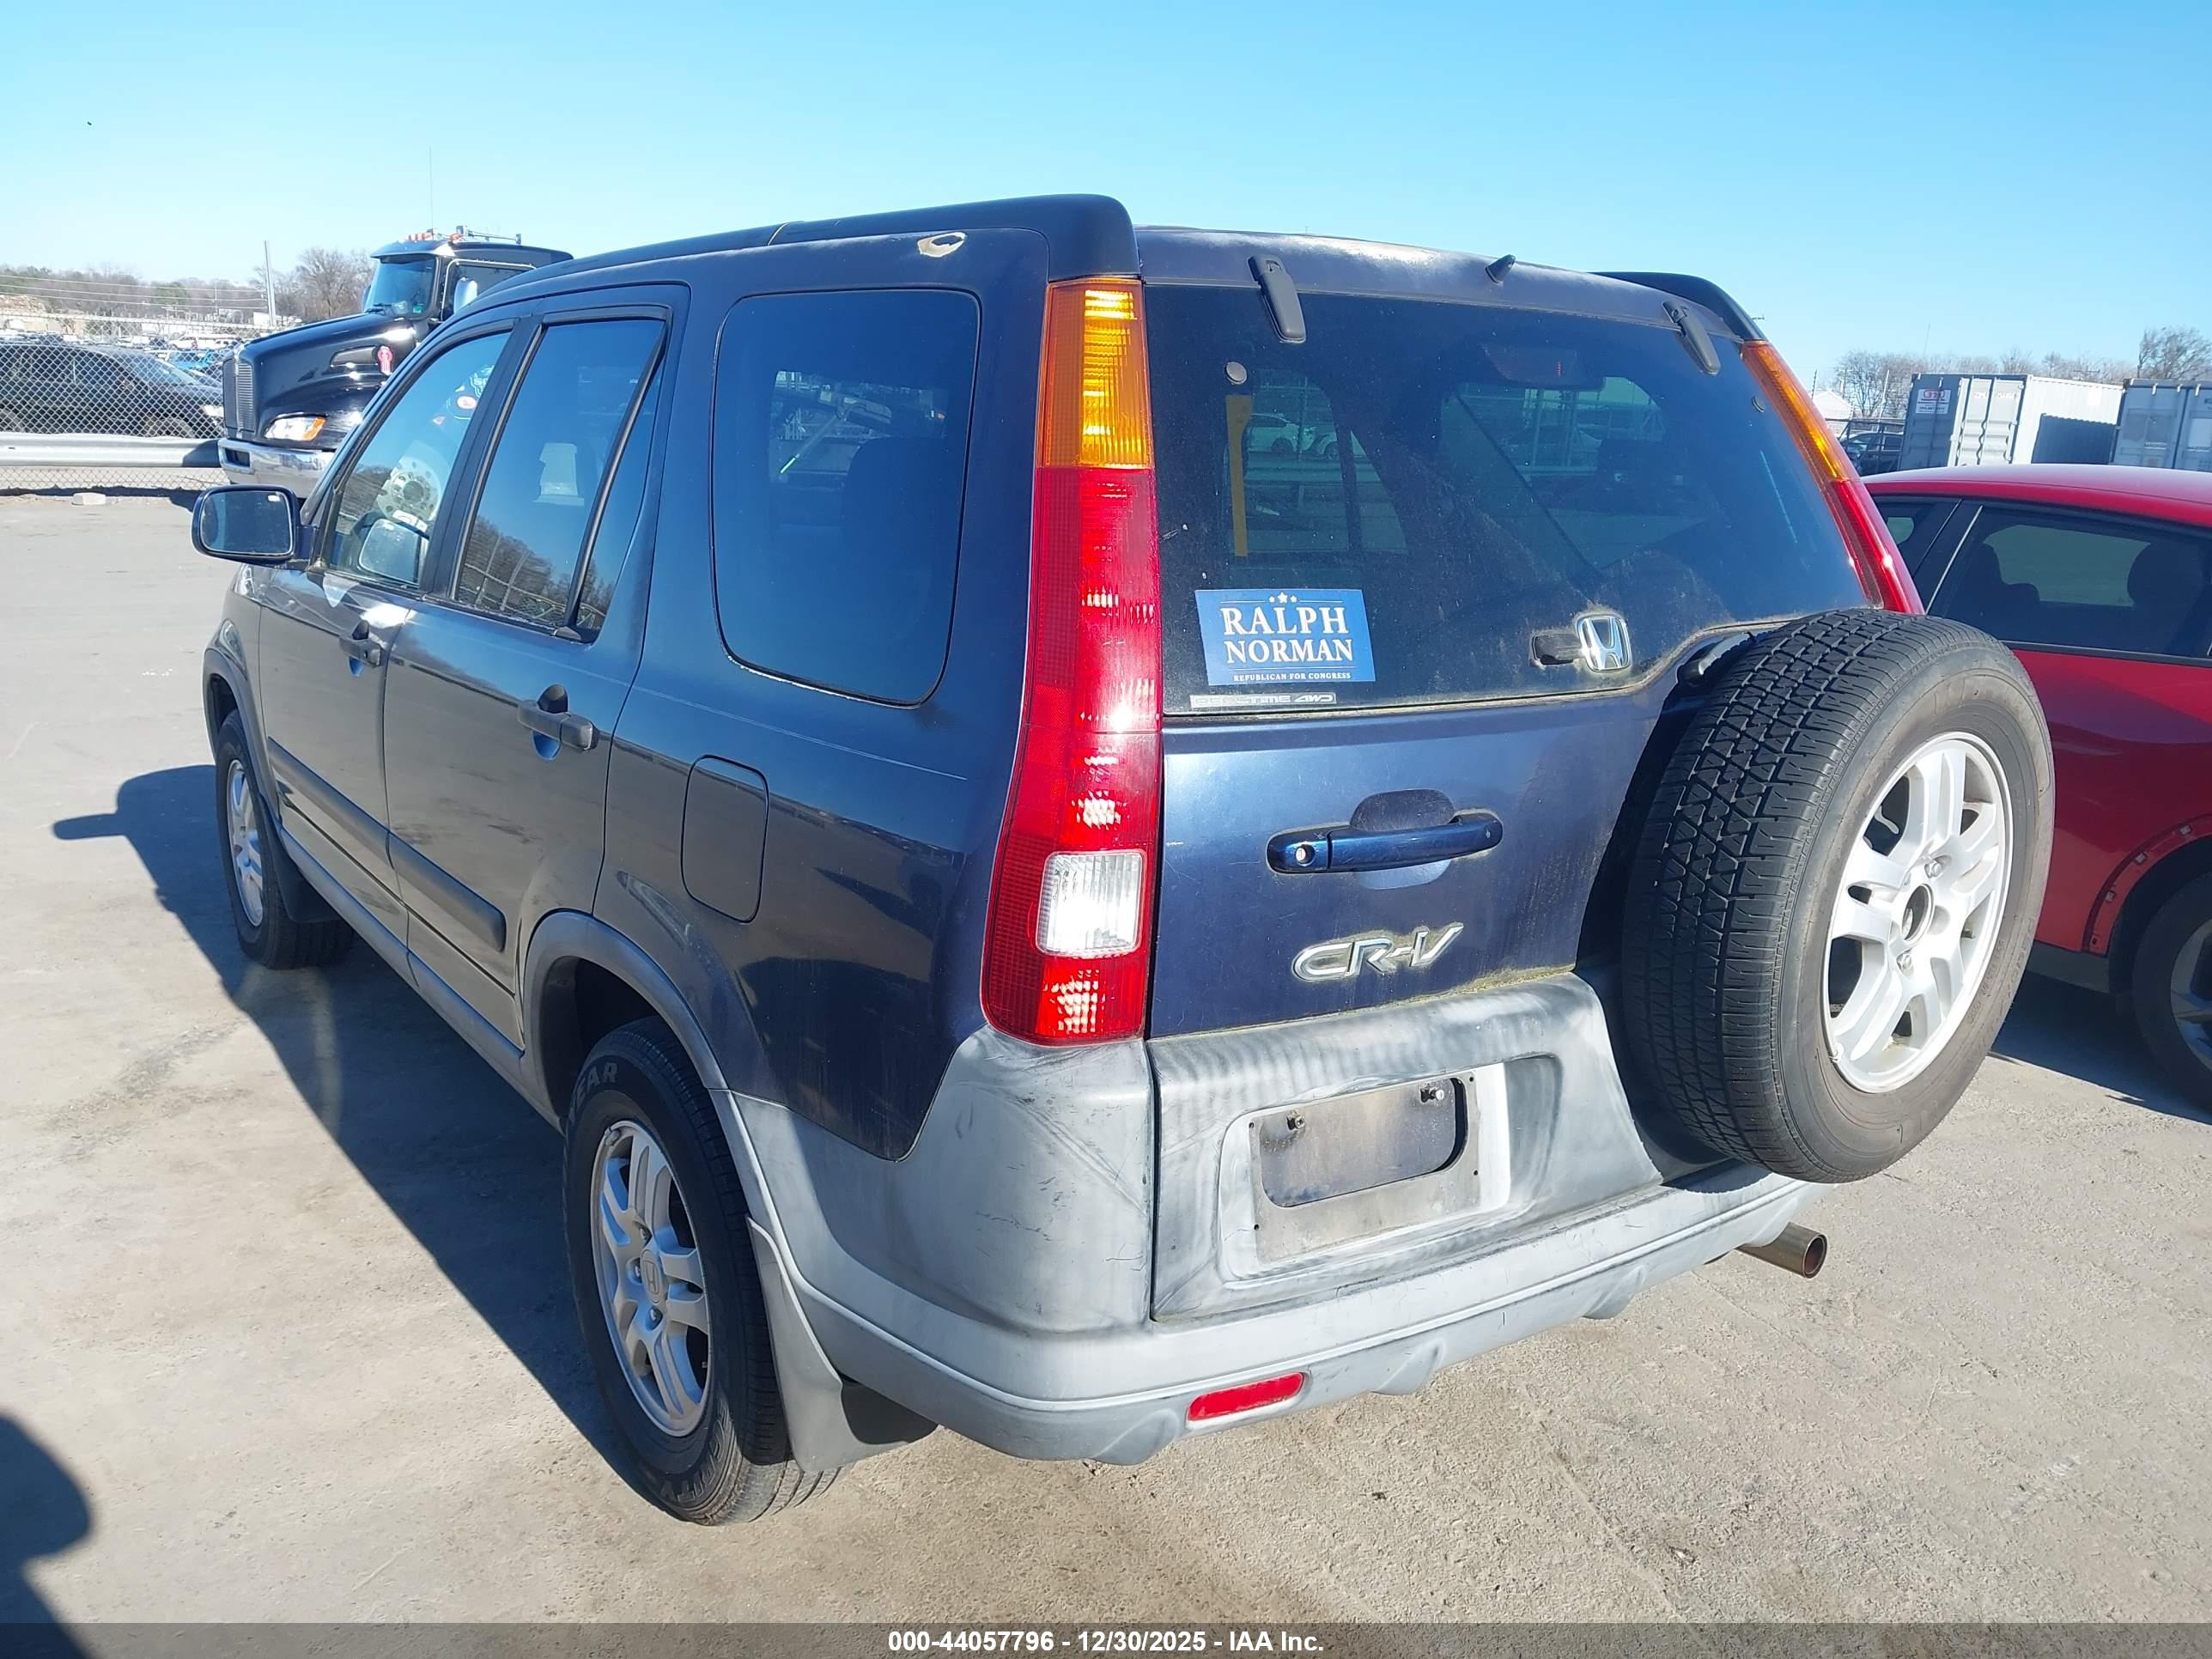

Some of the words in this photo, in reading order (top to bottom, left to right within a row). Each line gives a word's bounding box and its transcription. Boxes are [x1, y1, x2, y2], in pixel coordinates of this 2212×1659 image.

[1220, 607, 1348, 635] RALPH
[1224, 639, 1353, 664] NORMAN
[1233, 673, 1287, 682] REPUBLICAN
[1291, 921, 1464, 981] CR-V
